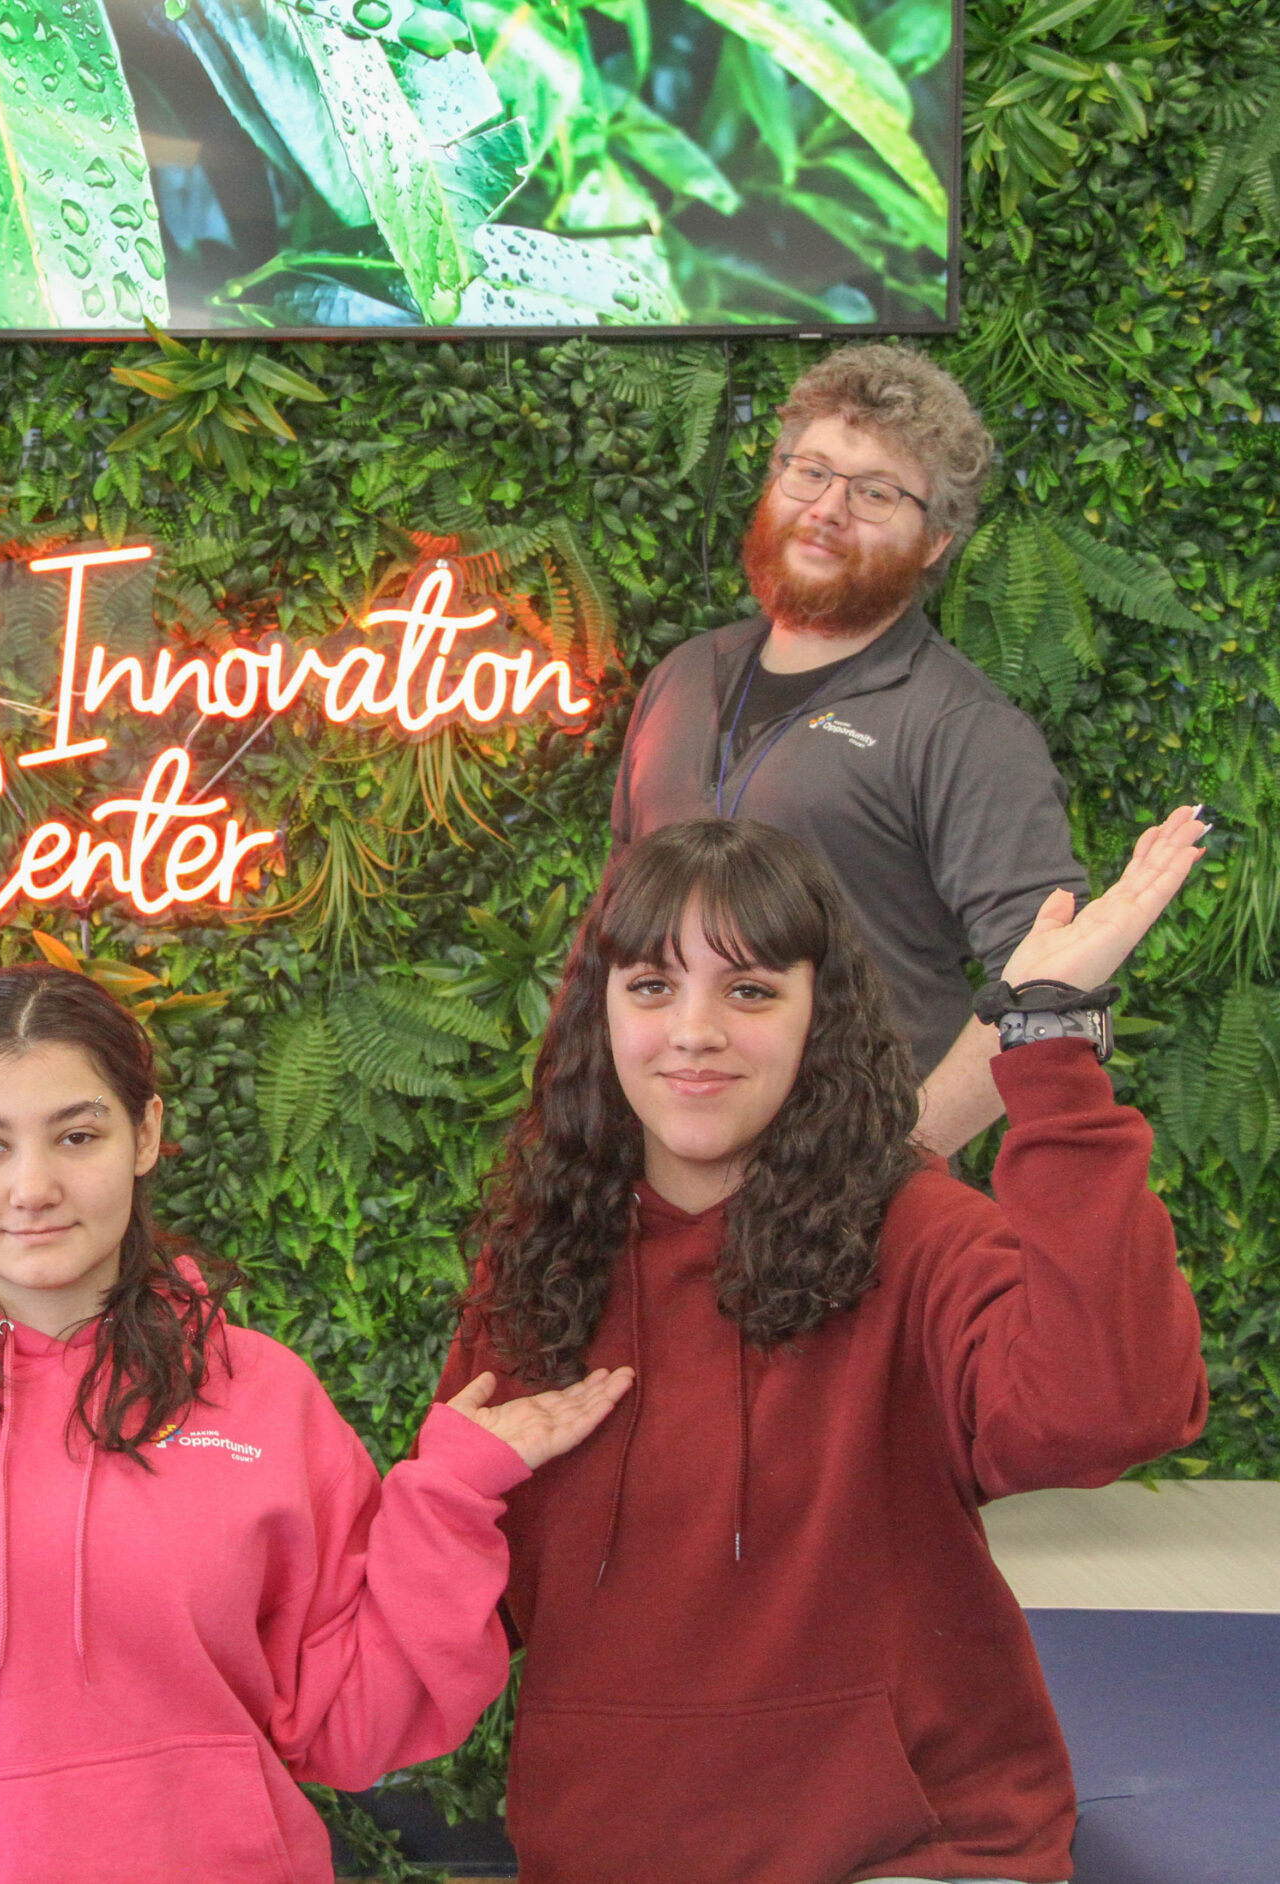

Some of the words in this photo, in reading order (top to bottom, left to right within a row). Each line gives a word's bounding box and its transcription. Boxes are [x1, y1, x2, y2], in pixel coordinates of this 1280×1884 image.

[19, 545, 592, 769] Innovation
[822, 721, 877, 747] Opportunity
[178, 1435, 262, 1459] Opportunity
